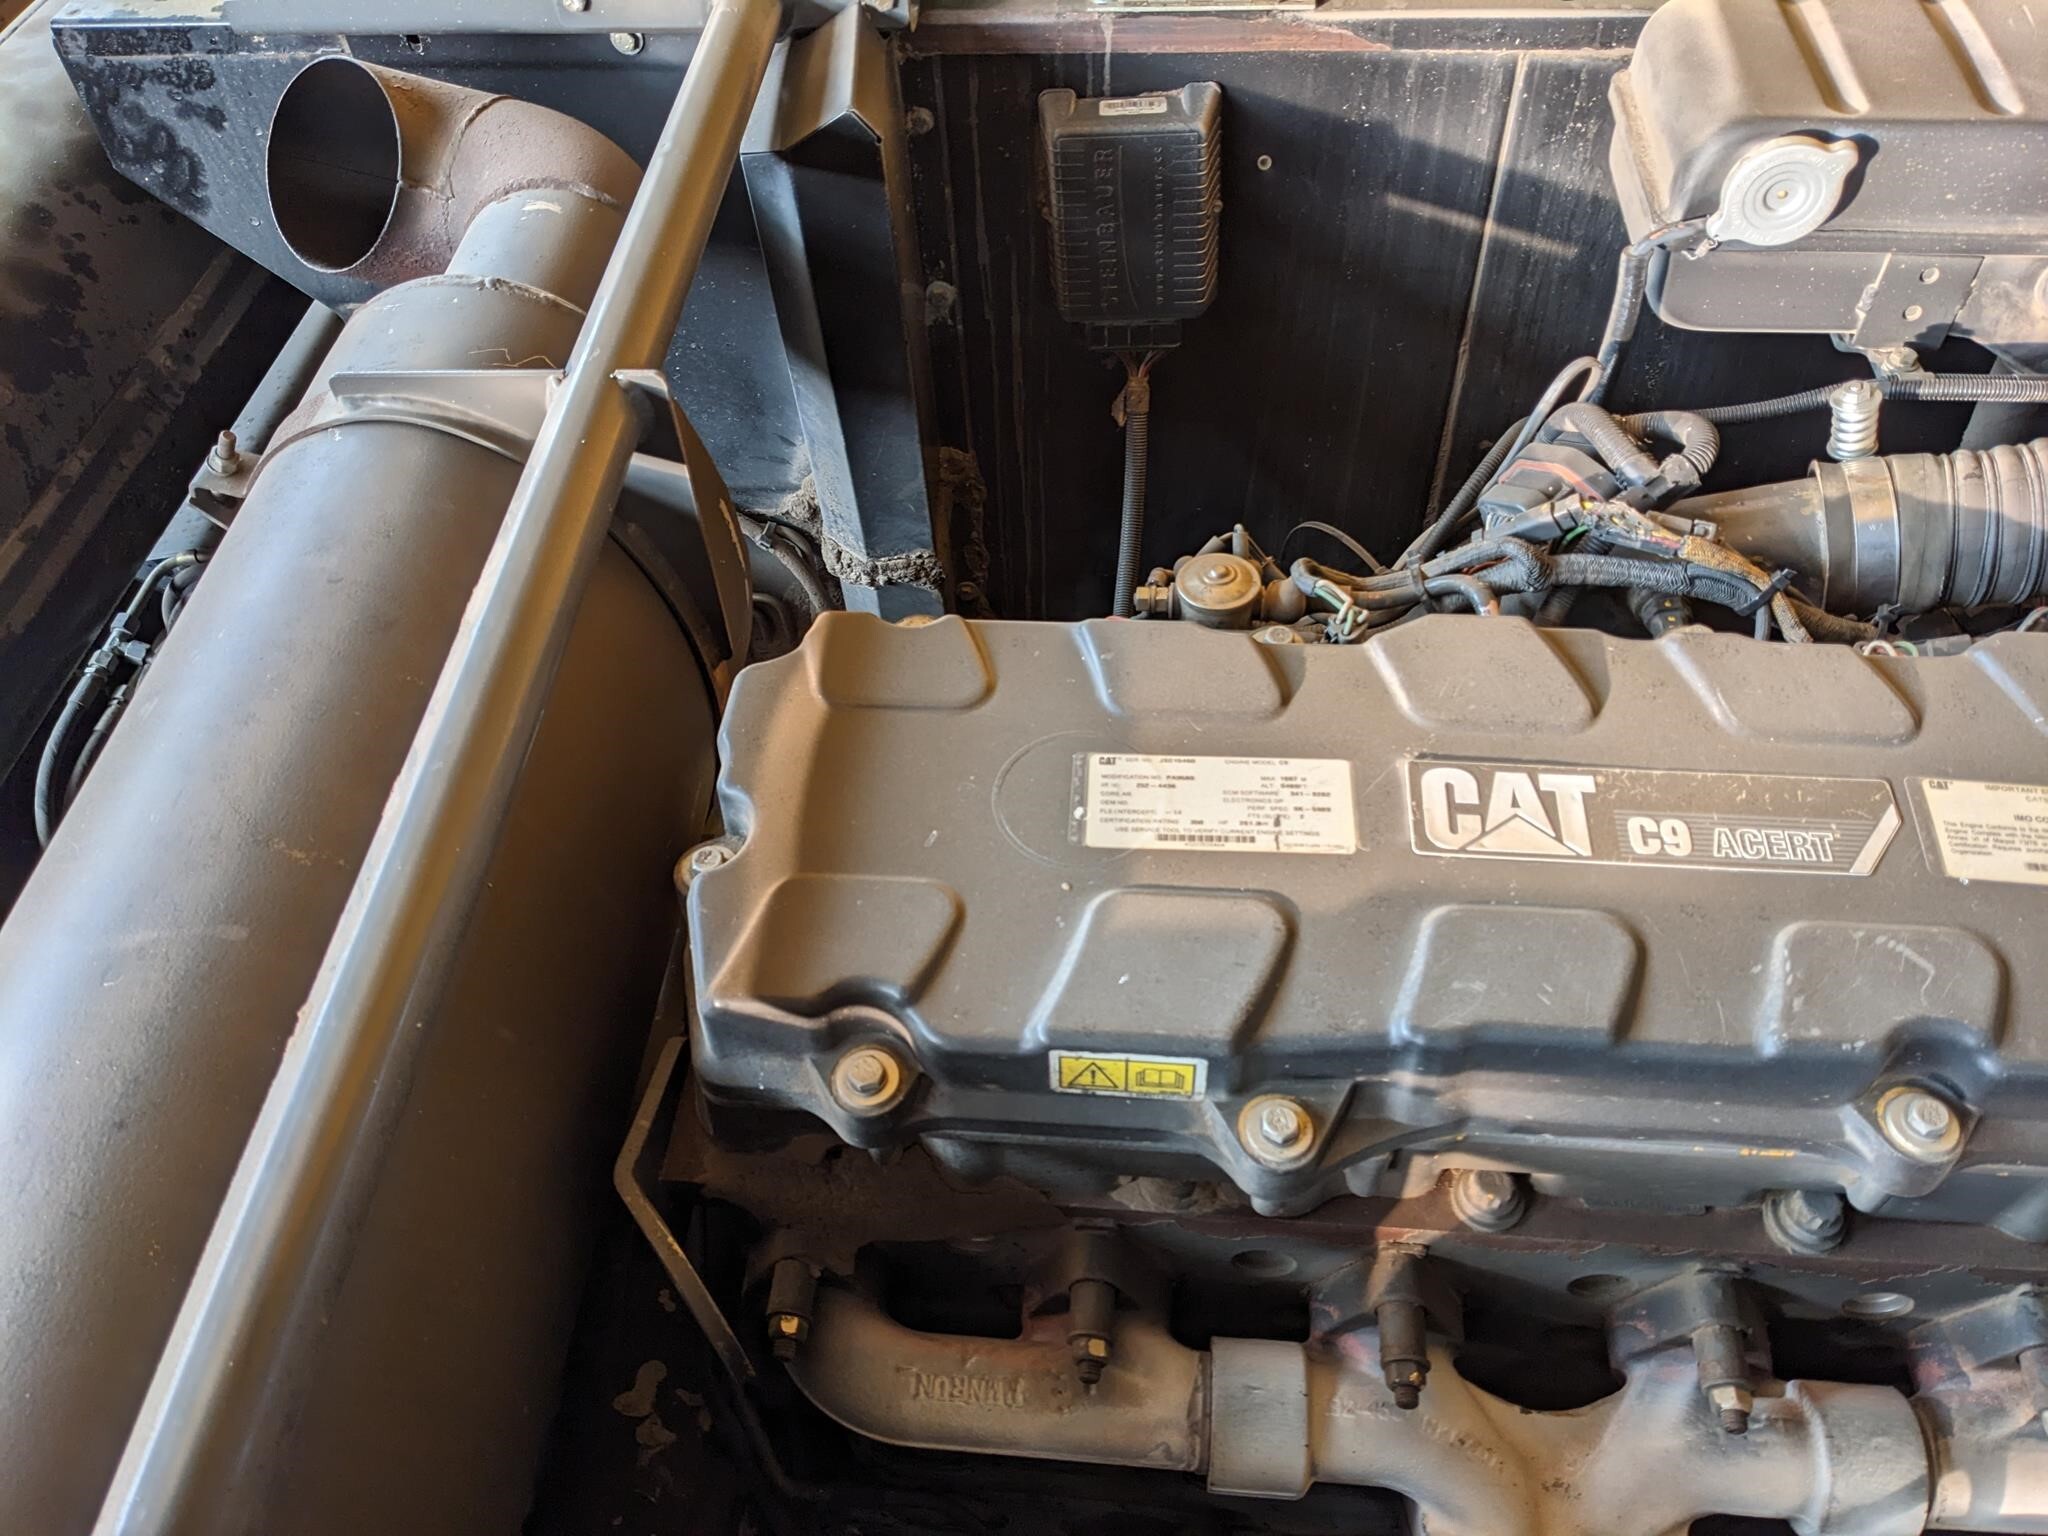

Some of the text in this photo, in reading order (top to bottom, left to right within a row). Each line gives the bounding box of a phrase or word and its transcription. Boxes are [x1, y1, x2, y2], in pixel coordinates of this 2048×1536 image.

[1420, 767, 1597, 857] CAT
[1985, 784, 2038, 794] IMPORTANT
[1627, 816, 1835, 862] C9 ACERT
